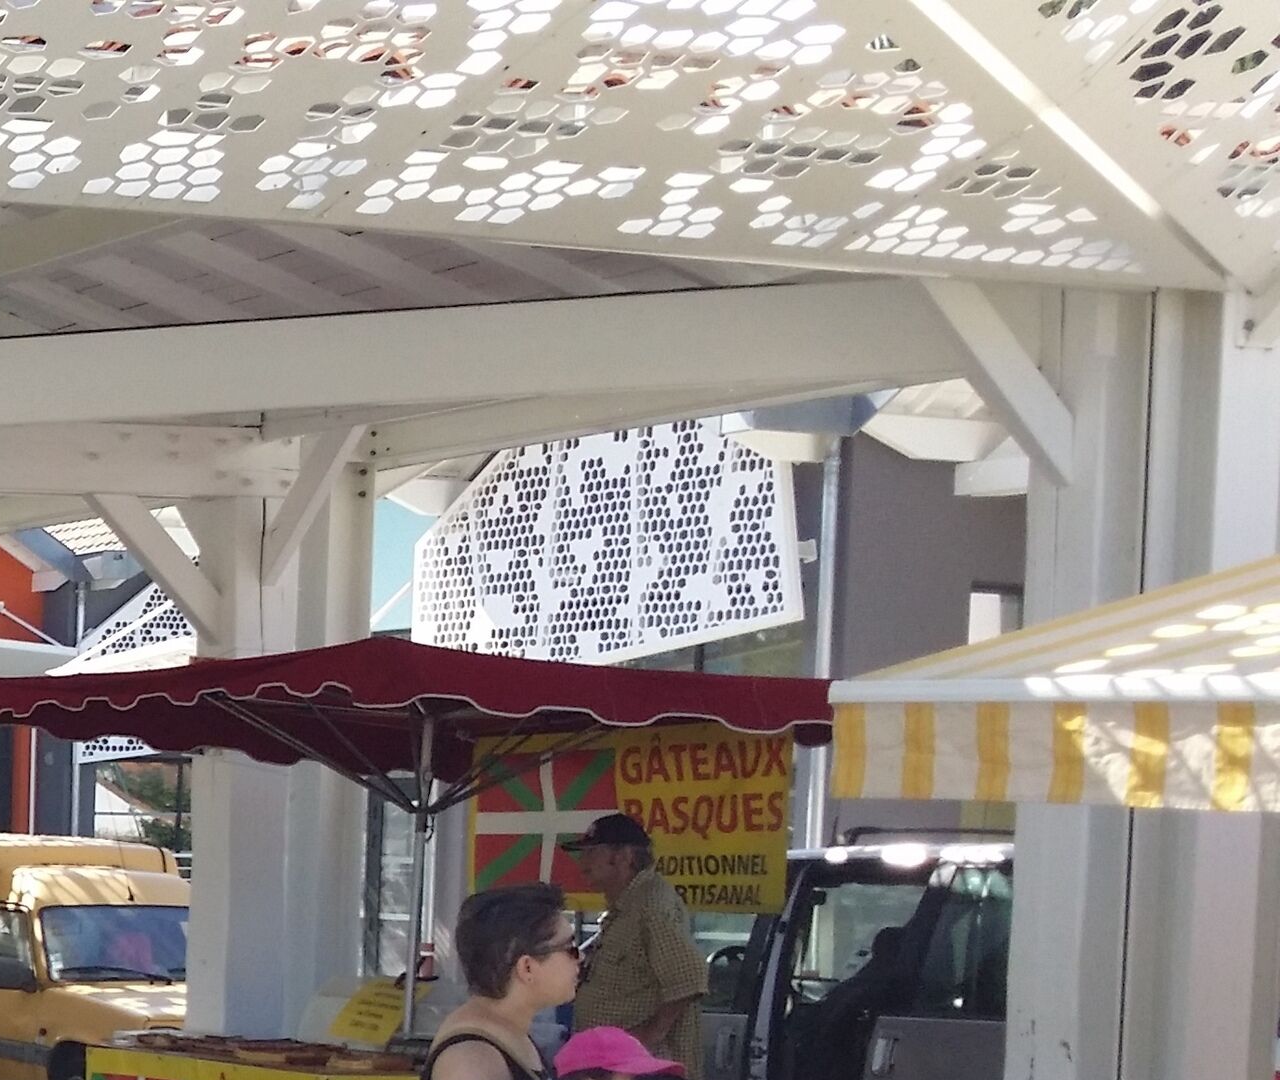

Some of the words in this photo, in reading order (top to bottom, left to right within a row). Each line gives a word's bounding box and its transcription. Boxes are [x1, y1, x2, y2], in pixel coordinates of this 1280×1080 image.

[620, 733, 787, 785] GÂTEAUX
[624, 791, 784, 839] BASQUES
[656, 854, 768, 876] ADITIONNEL
[674, 884, 762, 906] RTISANAL
